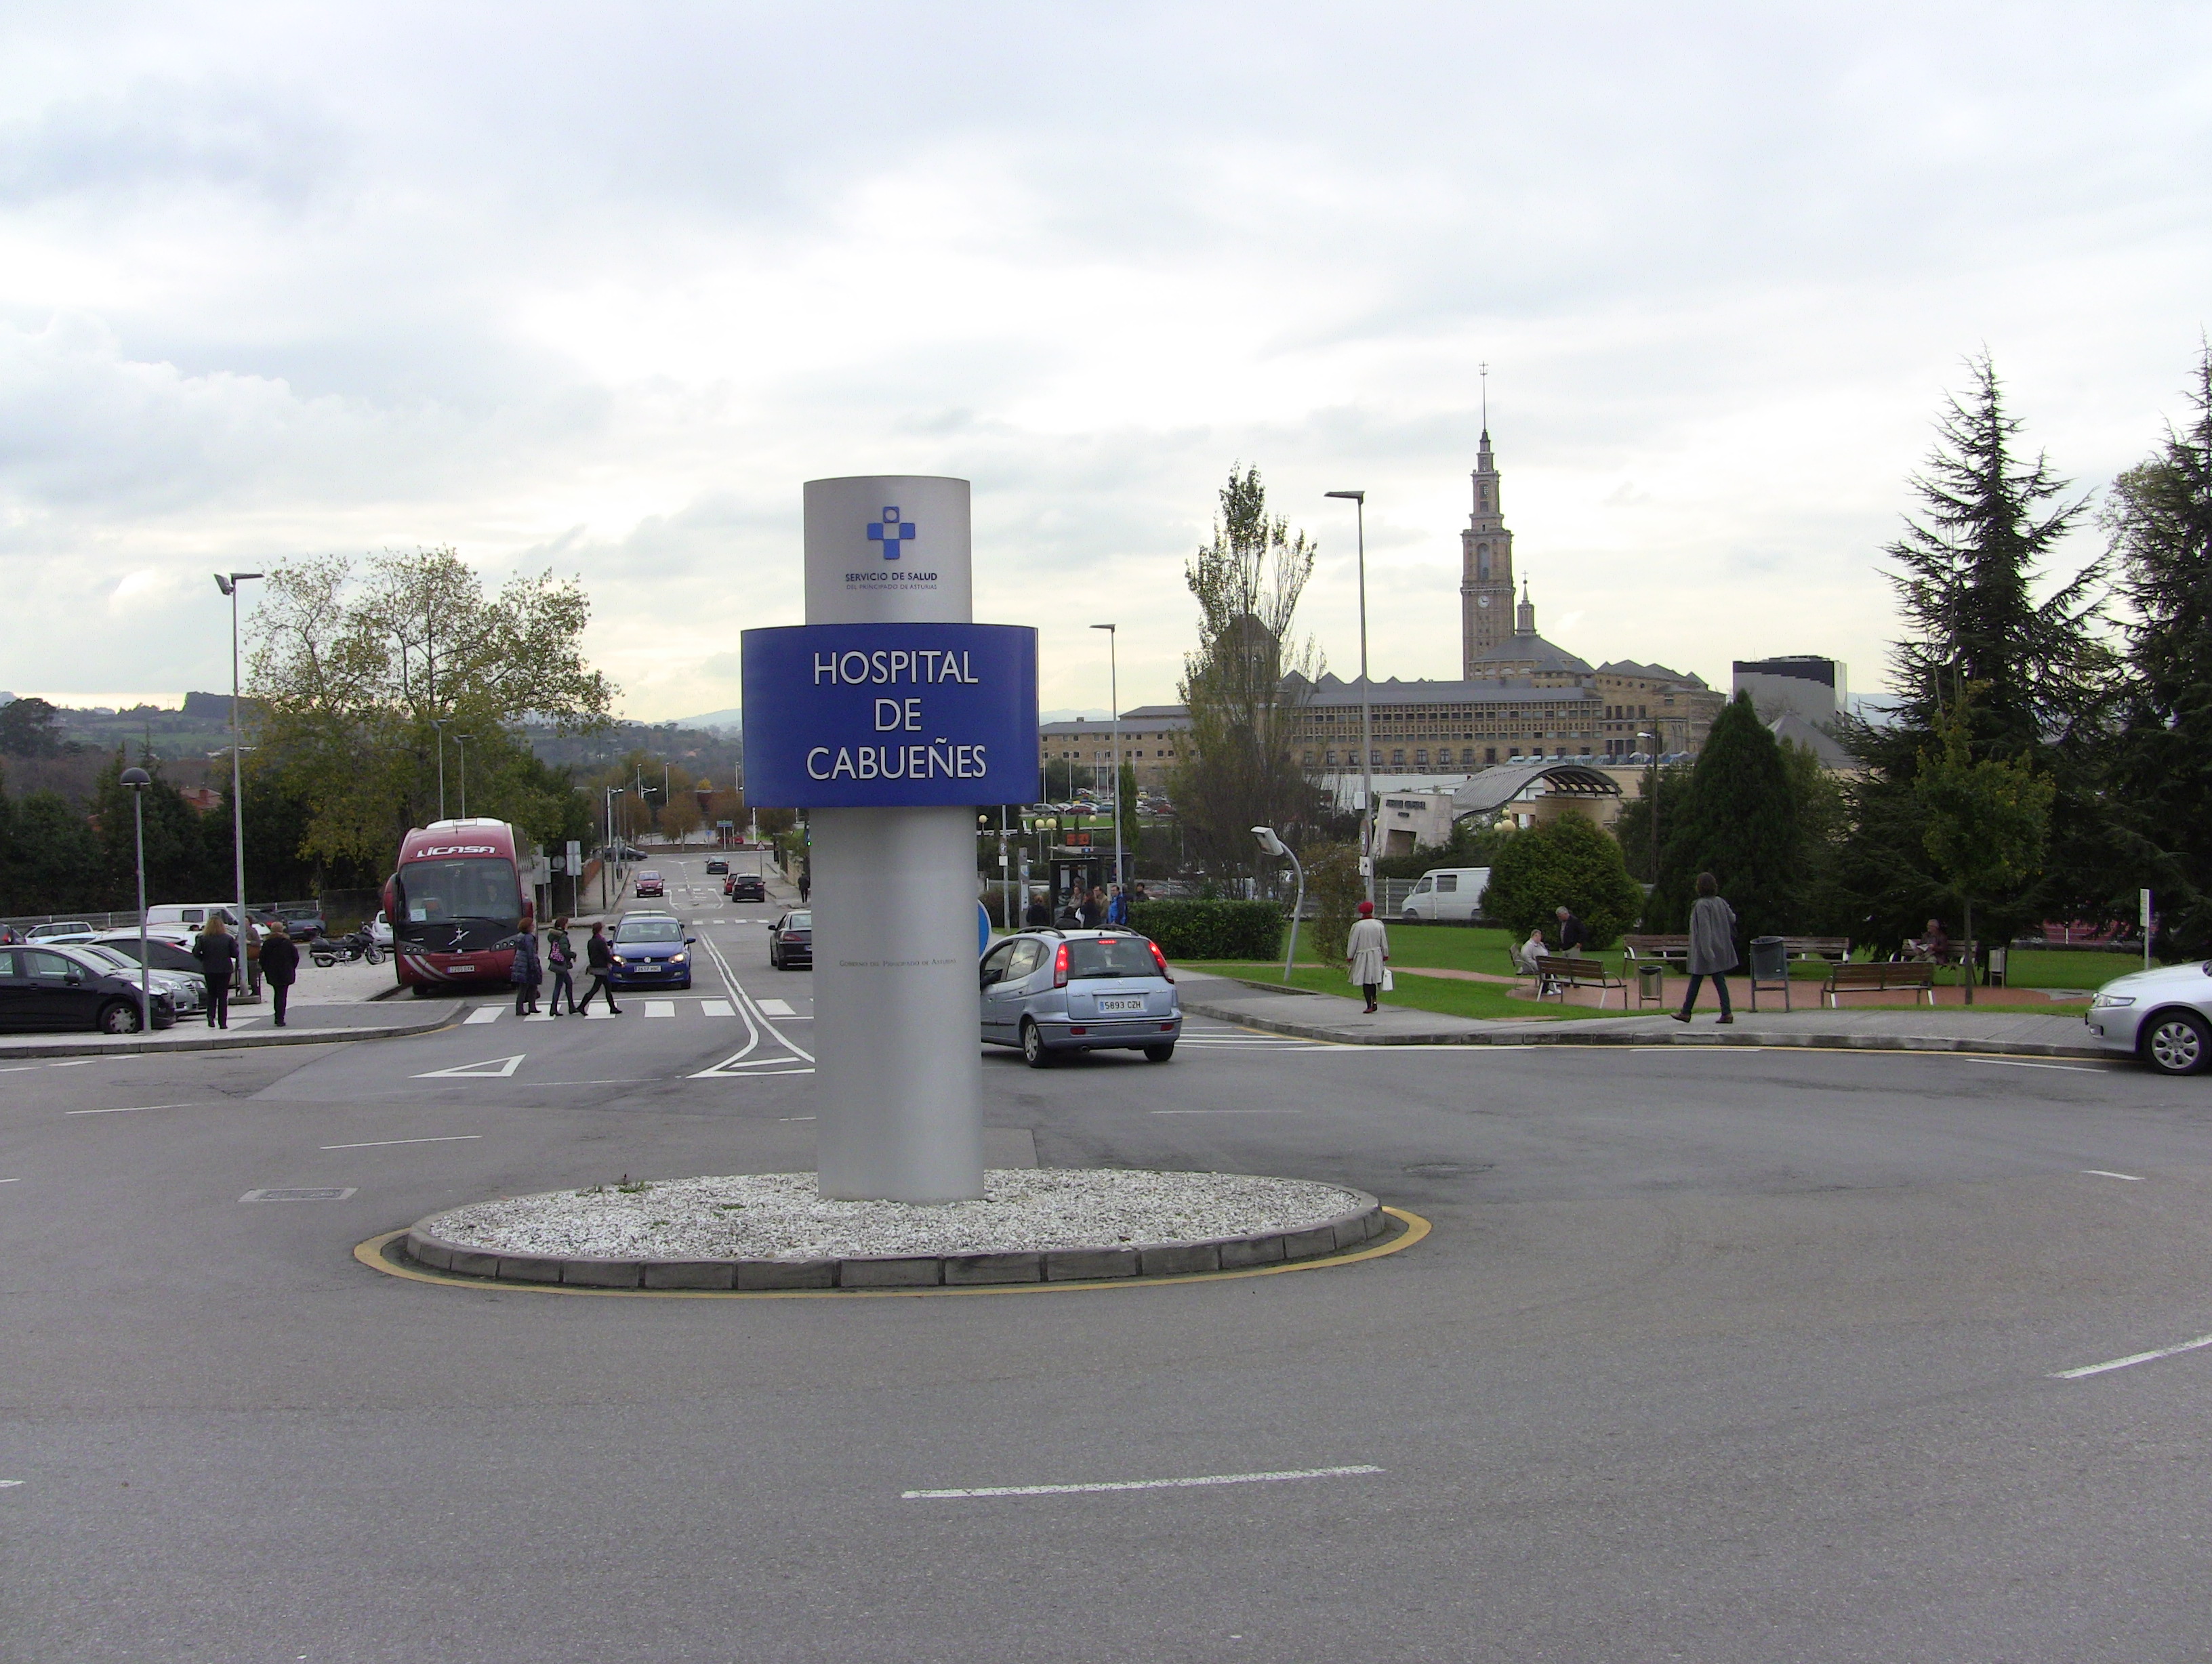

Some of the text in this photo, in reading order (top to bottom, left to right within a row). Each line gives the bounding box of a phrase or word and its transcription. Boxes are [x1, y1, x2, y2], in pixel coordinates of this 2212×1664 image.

[845, 573, 938, 582] SERVICIO DE SALUD
[814, 650, 979, 685] HOSPITAL
[874, 697, 922, 732] DE
[806, 737, 987, 781] CABUEÑES
[1105, 1001, 1141, 1010] 5893 CZH
